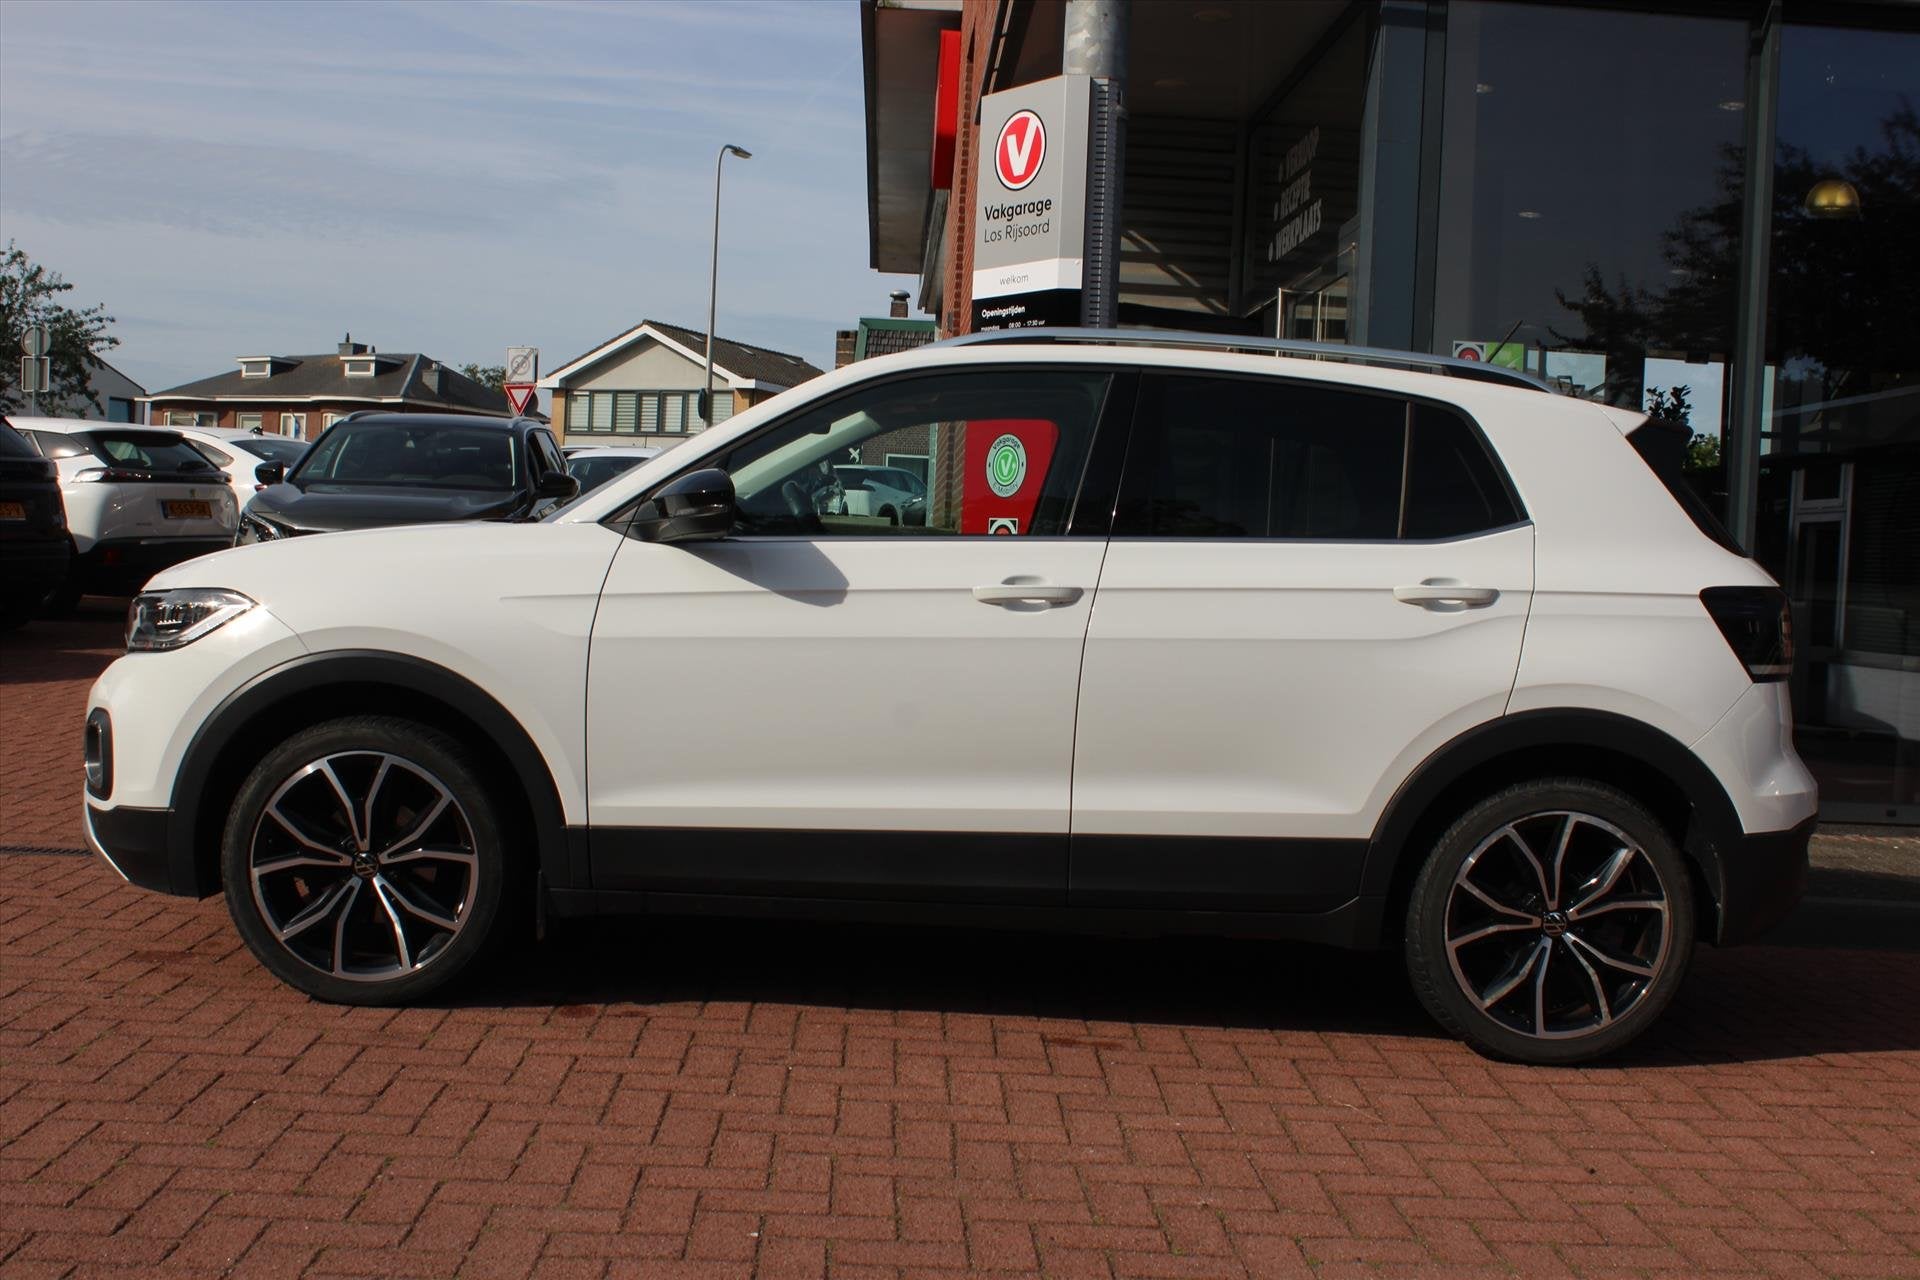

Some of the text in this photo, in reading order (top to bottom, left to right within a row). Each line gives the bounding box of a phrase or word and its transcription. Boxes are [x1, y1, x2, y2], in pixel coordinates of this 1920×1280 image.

[984, 198, 1052, 222] Vakgarage
[984, 219, 1050, 243] Los Rijsoord
[1275, 198, 1323, 261] WERKPLAATS
[999, 273, 1029, 286] welkom
[981, 305, 1026, 319] Openingstijden
